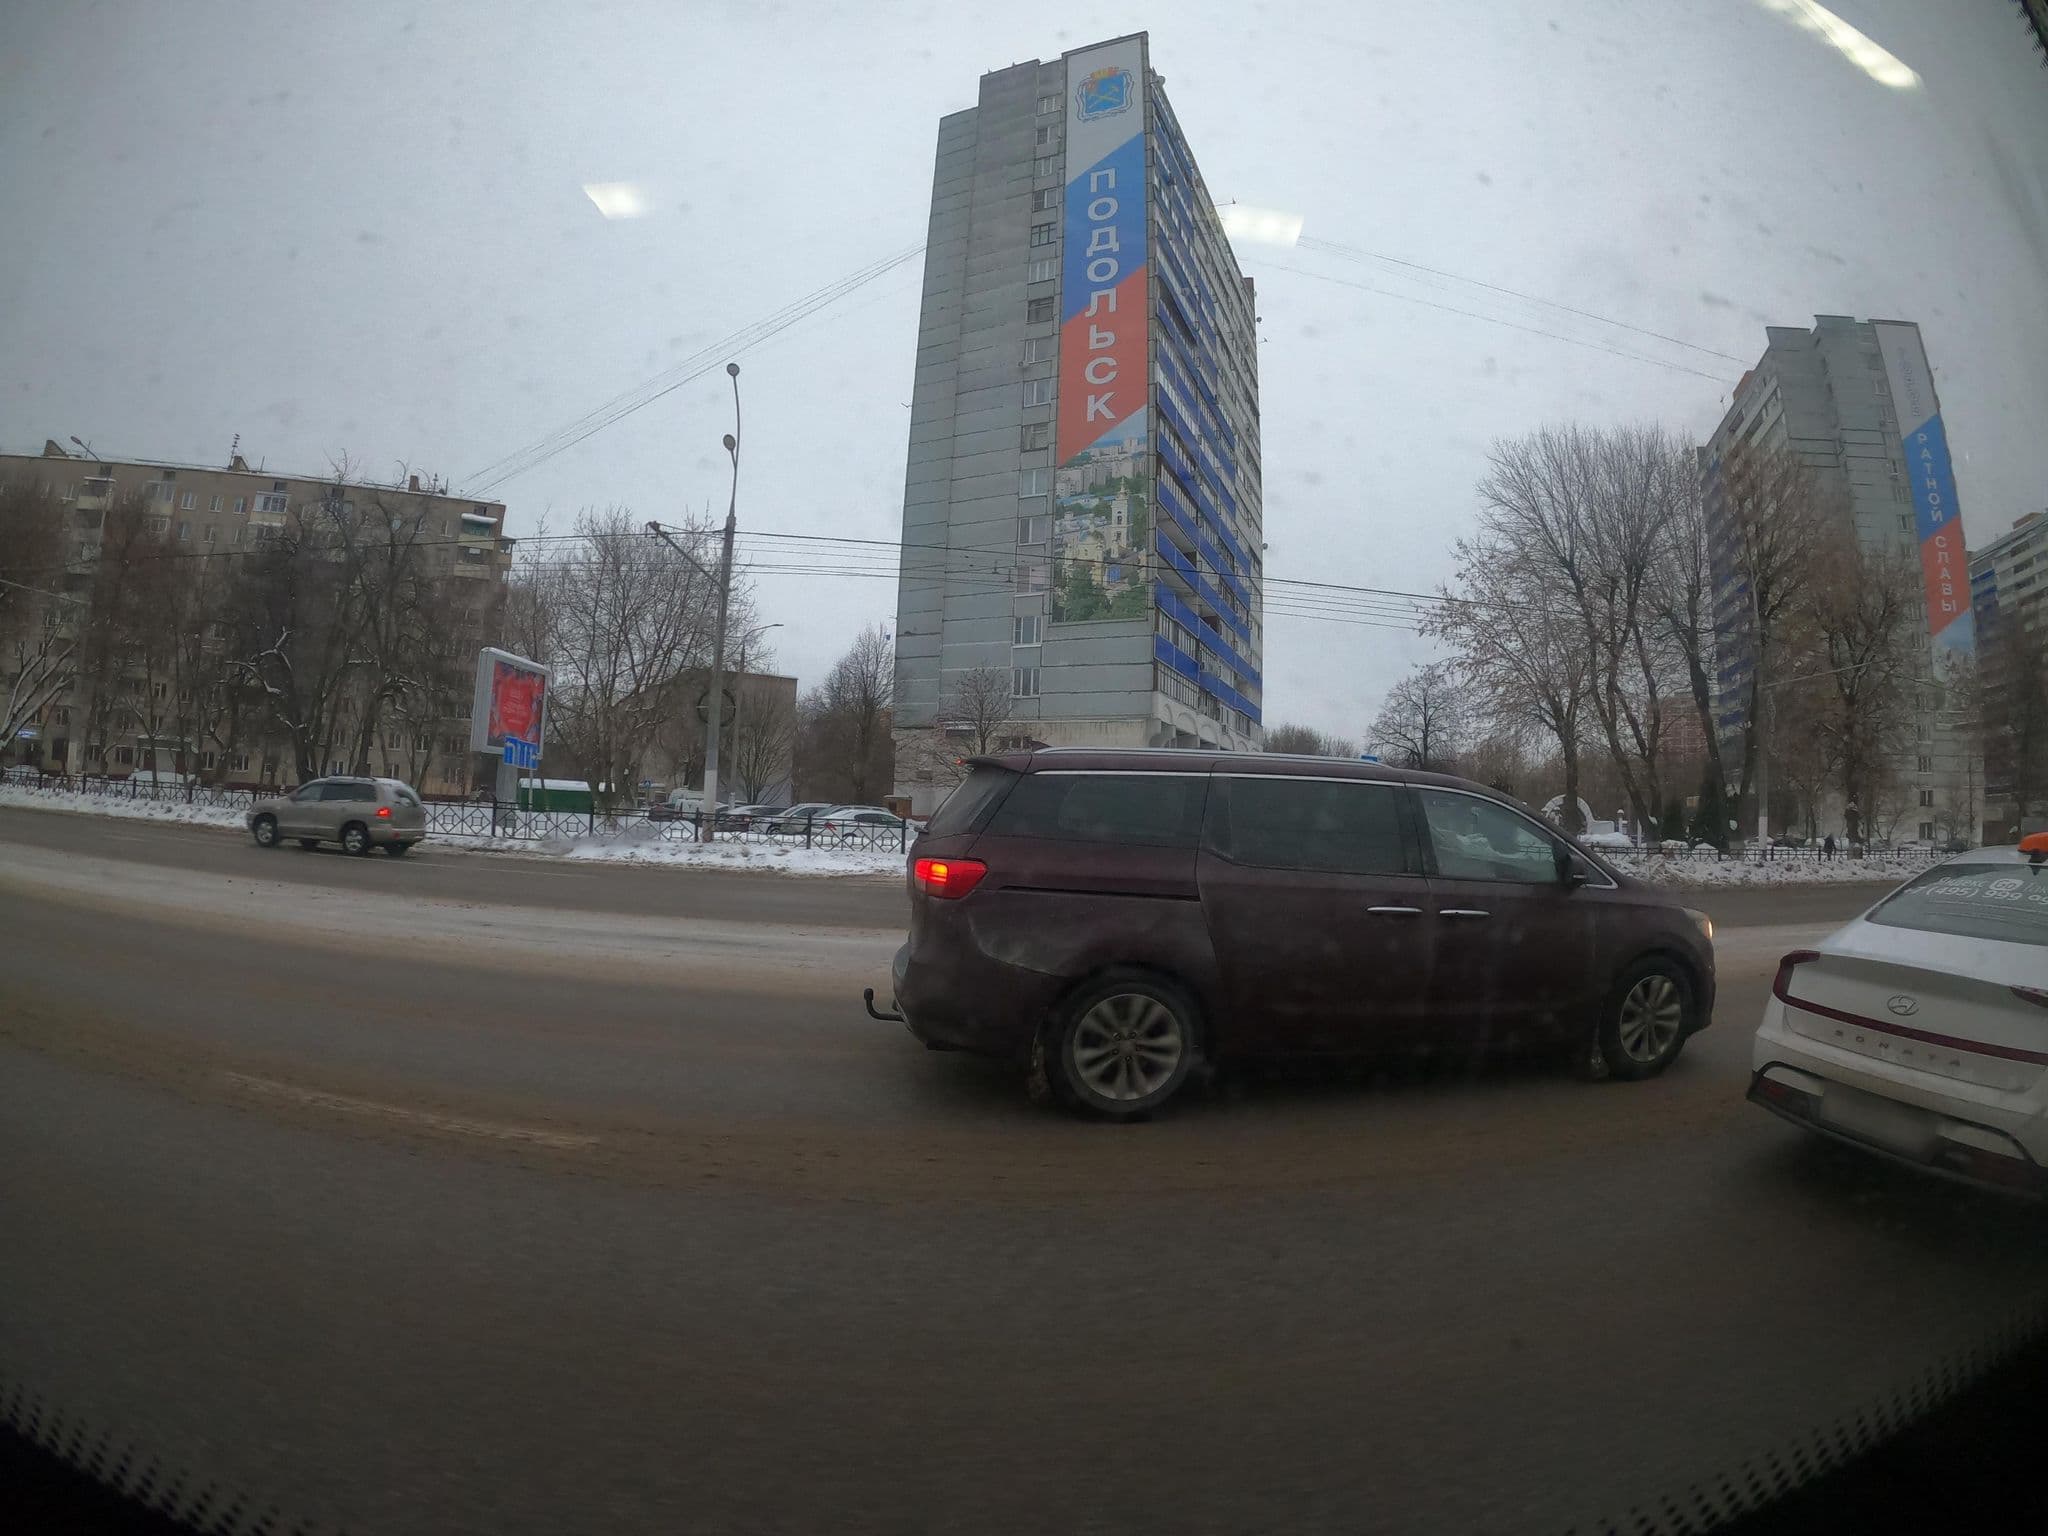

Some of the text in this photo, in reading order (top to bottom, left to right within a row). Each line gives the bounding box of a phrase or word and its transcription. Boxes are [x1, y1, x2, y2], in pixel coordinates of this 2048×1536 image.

[1085, 167, 1120, 422] ПОДОЛЬСК
[1917, 433, 1957, 612] РАТНОЙ СЛАВЫ
[1926, 886, 1979, 898] (495)
[1982, 890, 2023, 900] 999
